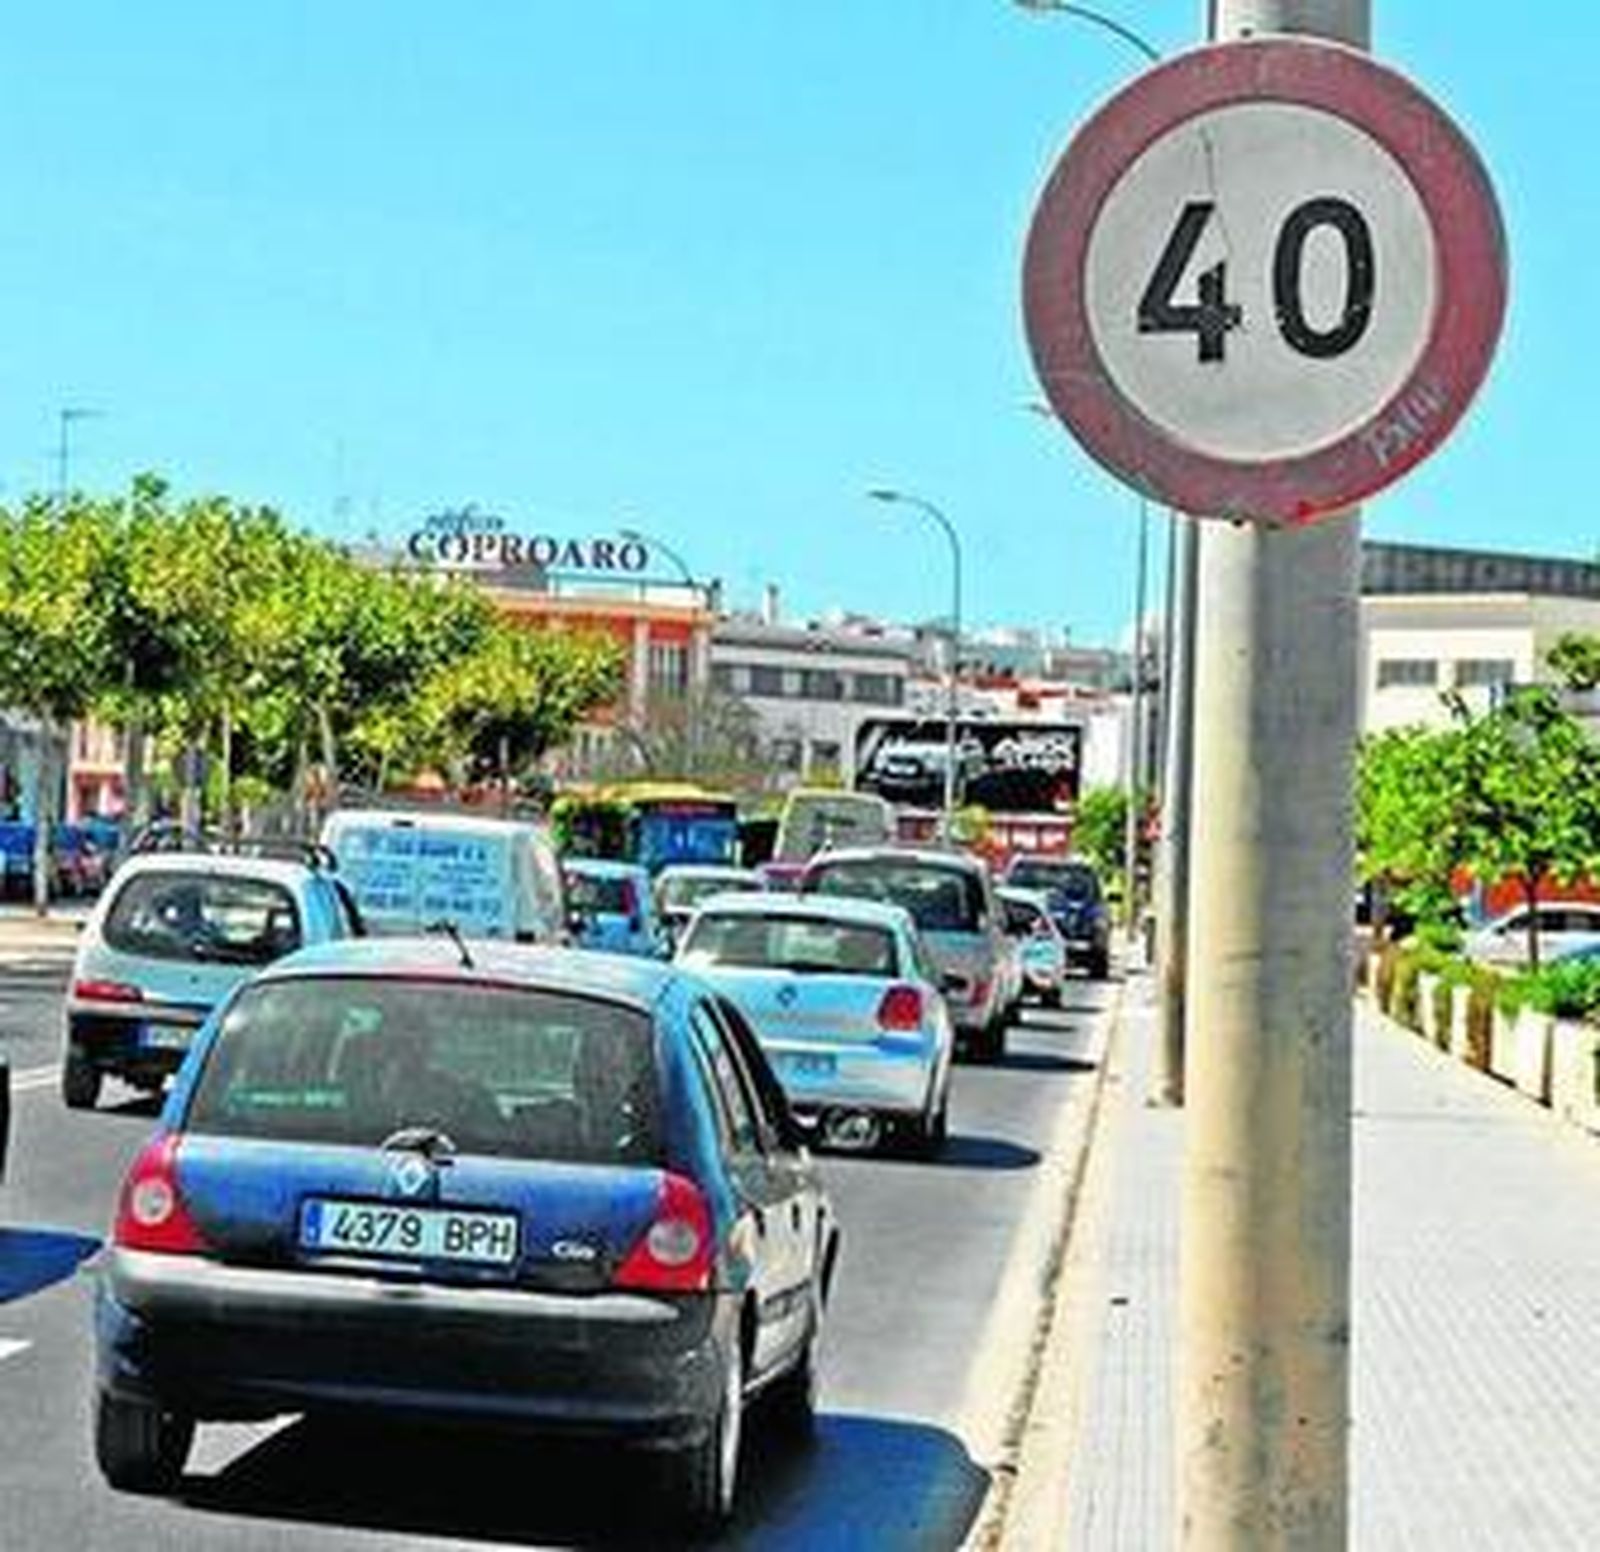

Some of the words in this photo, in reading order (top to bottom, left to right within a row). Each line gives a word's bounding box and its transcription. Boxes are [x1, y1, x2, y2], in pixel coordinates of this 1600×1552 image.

[1138, 198, 1375, 363] 40
[407, 531, 649, 571] COPROARO
[332, 1208, 422, 1248] 4379
[444, 1217, 513, 1256] BPH
